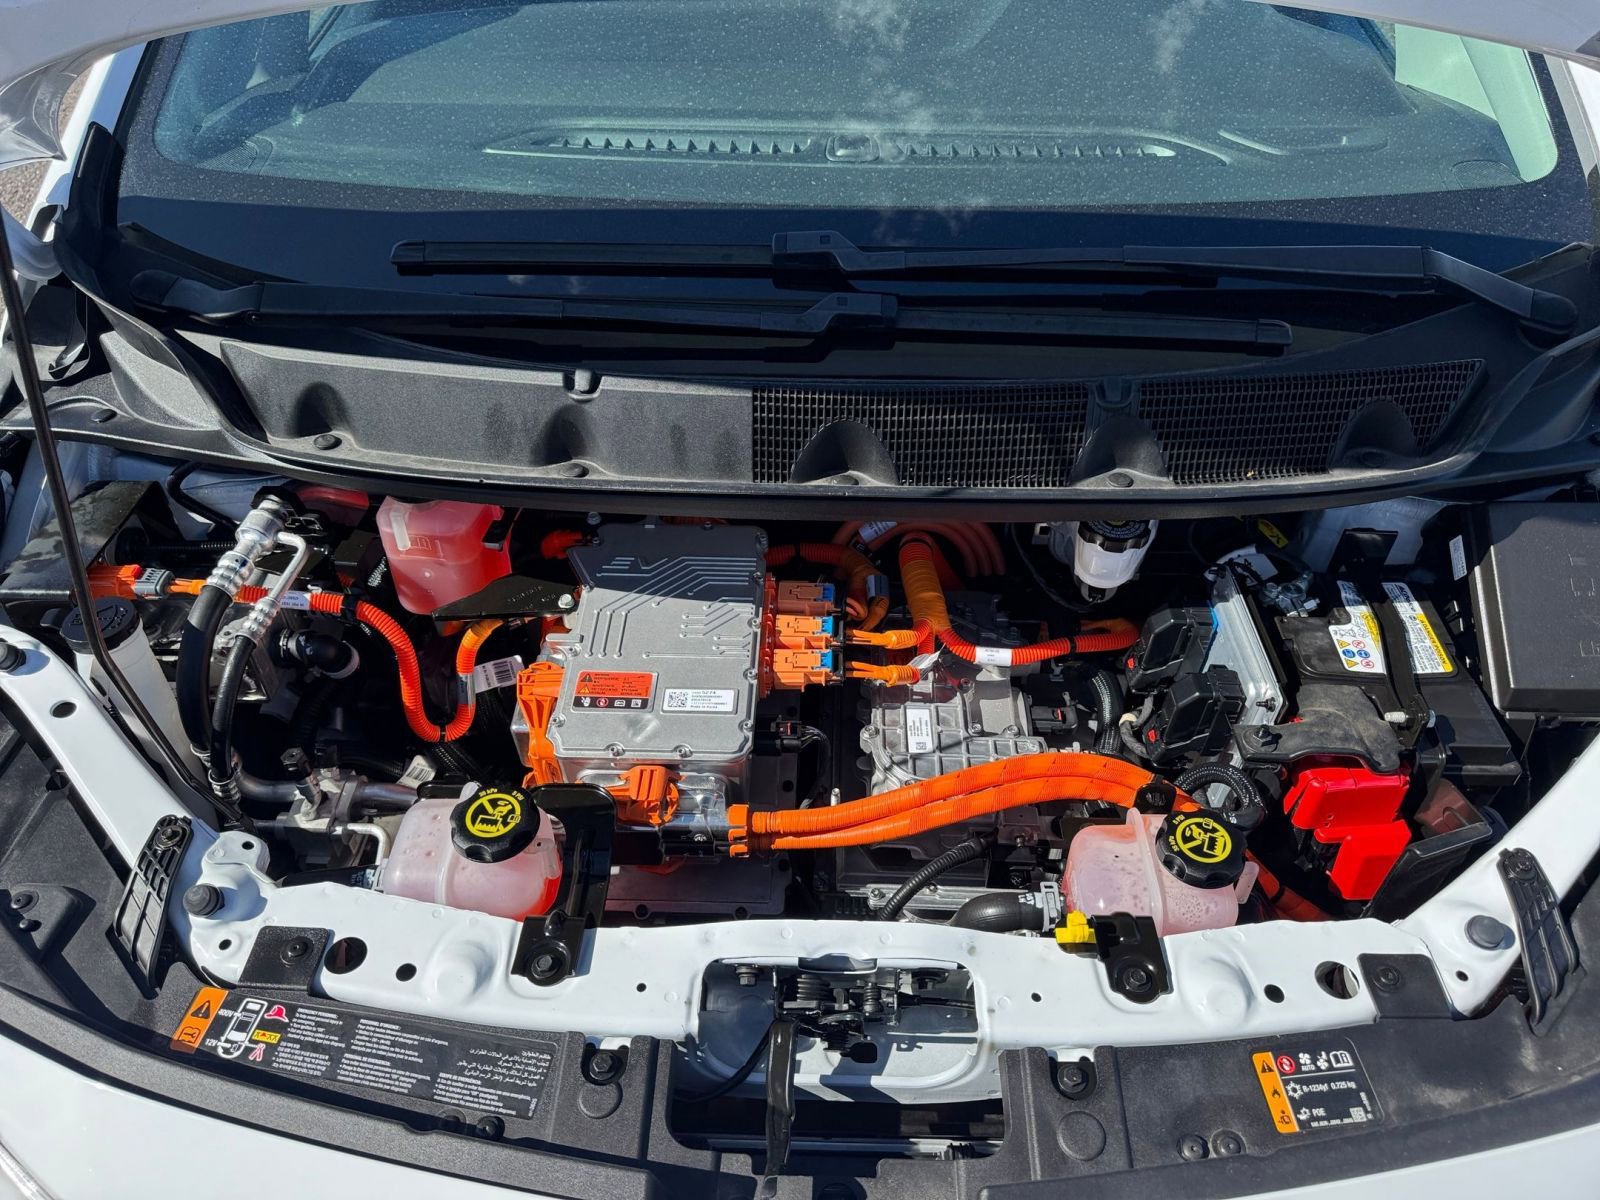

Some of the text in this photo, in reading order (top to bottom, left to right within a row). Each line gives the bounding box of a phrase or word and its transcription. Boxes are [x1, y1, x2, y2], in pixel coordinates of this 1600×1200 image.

[218, 1008, 234, 1017] 400V
[205, 1038, 218, 1047] 12V
[1347, 1081, 1357, 1089] kg
